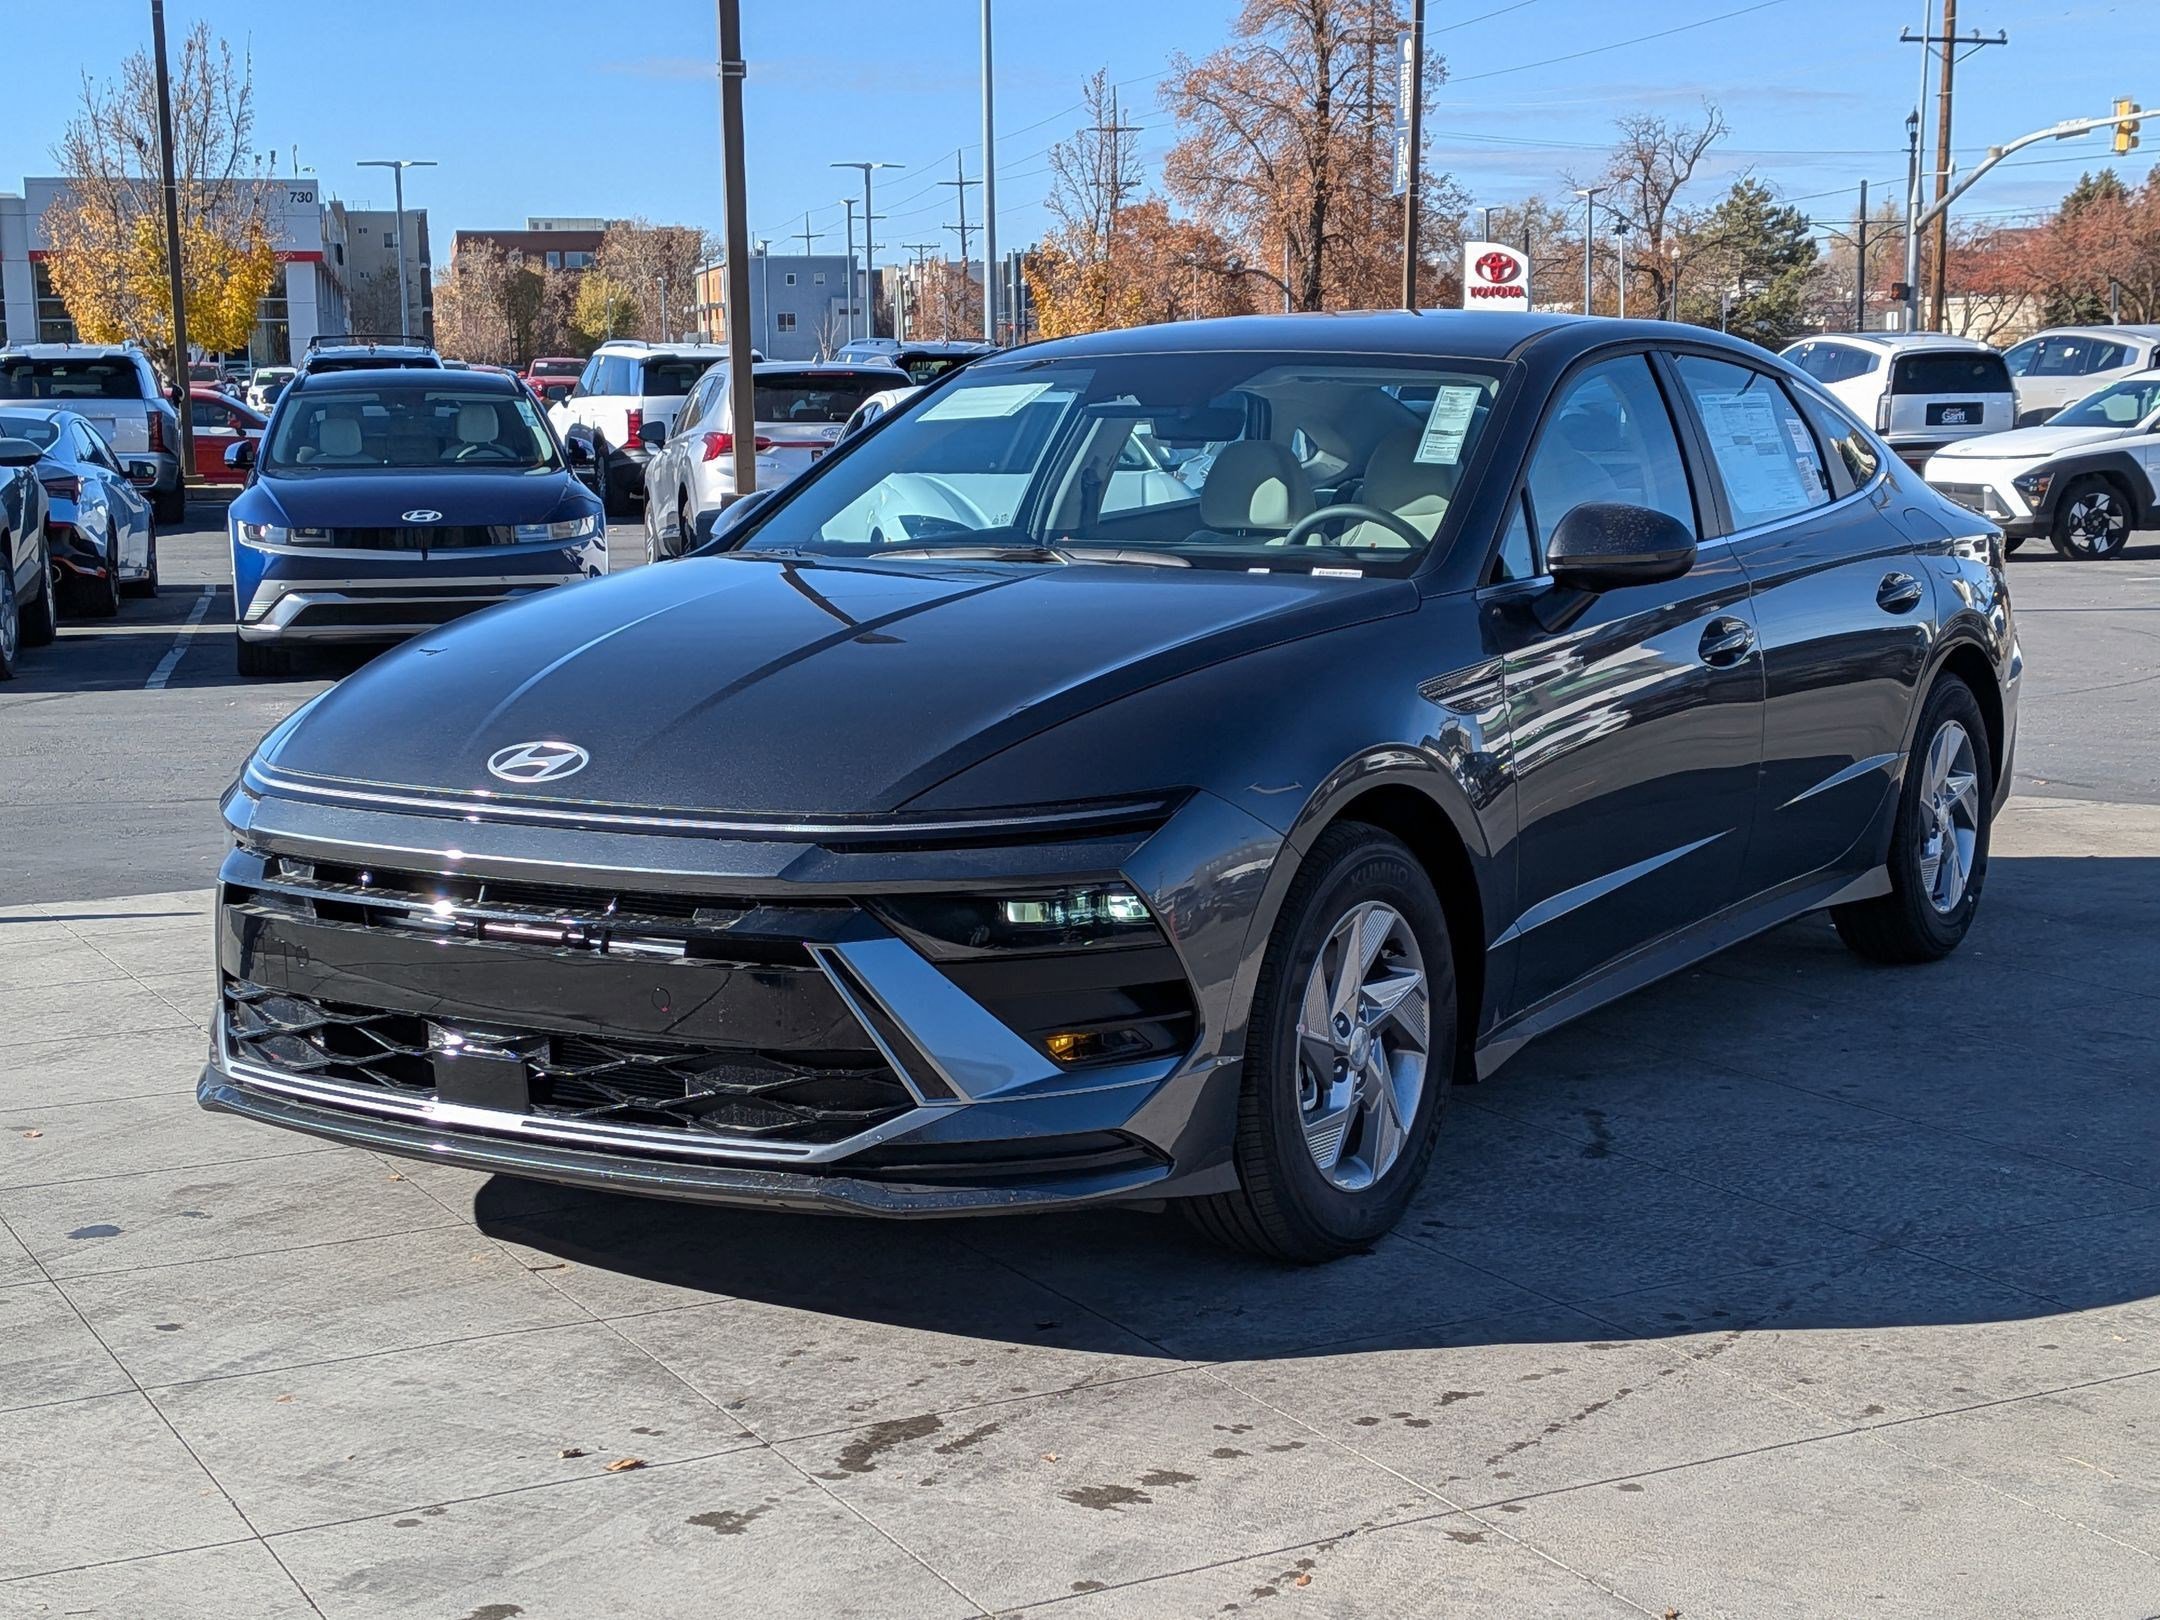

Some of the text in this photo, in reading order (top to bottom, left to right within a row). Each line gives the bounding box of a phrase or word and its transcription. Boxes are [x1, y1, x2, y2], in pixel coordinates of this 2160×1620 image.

[290, 191, 313, 203] 730
[1468, 285, 1528, 299] TOYOTA
[1350, 862, 1408, 886] KUMHO
